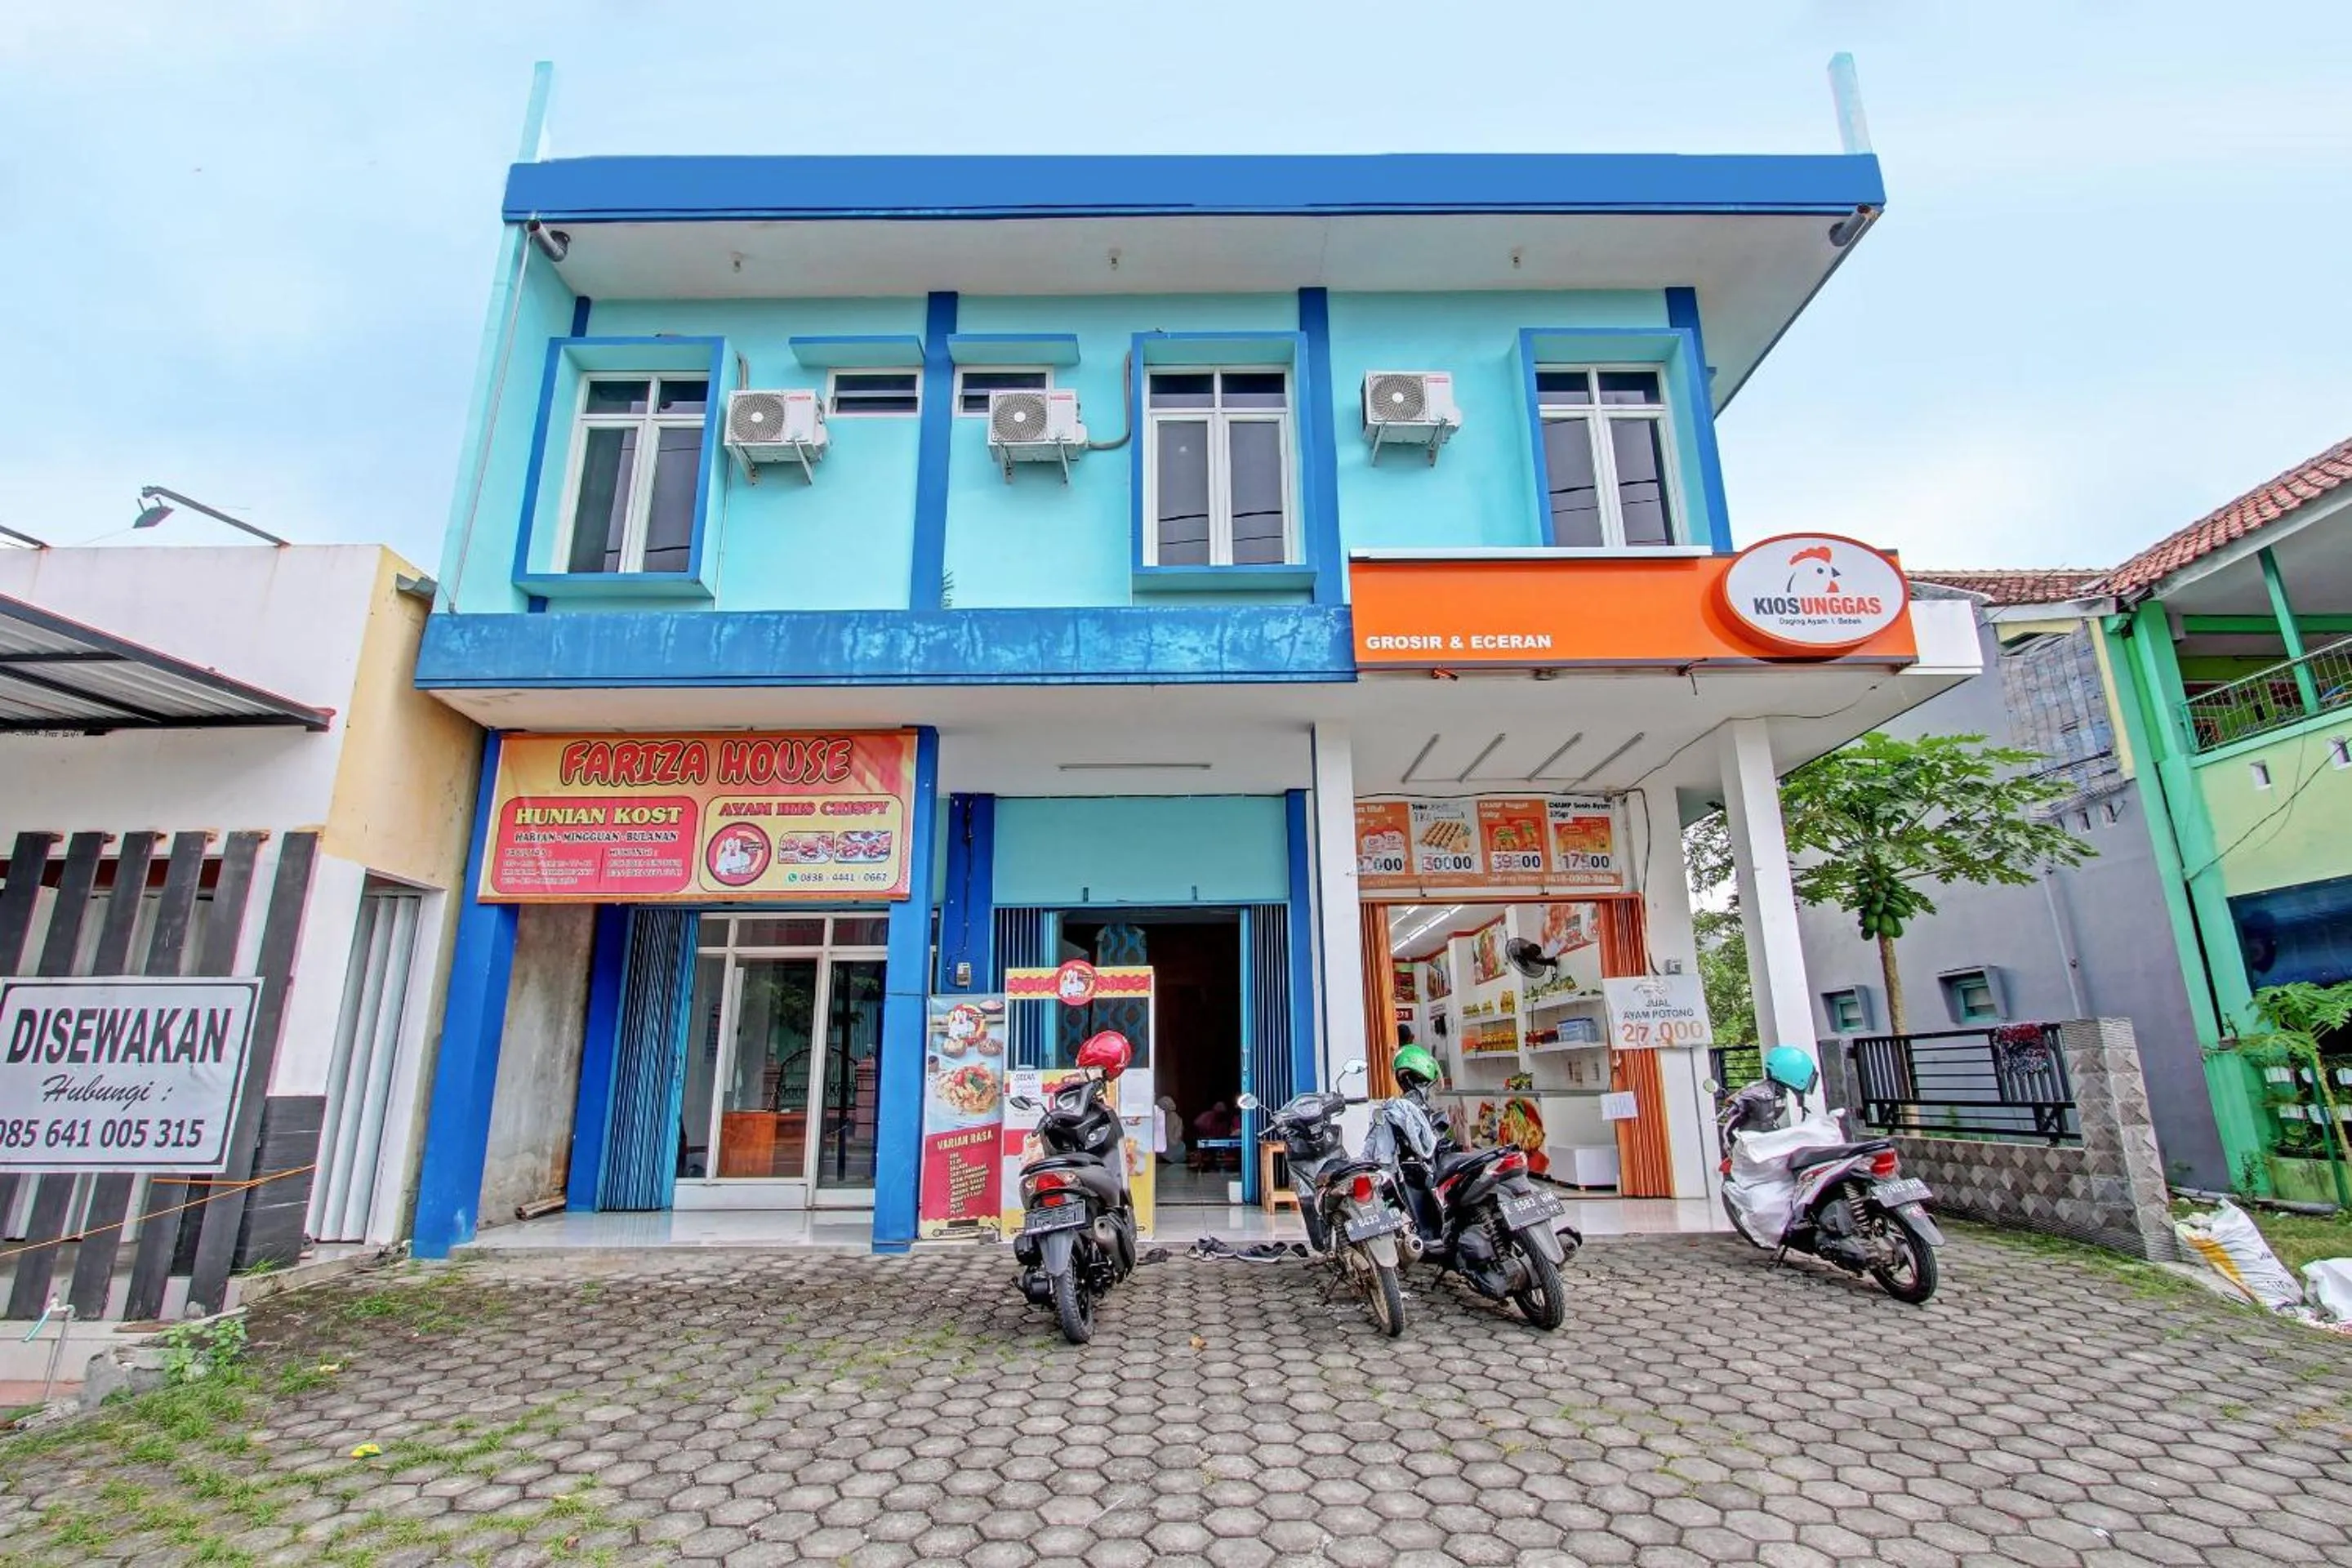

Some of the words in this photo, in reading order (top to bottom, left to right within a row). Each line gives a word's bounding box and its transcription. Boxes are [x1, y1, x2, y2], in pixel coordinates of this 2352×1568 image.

[1753, 597, 1882, 615] KIOSUNGGAS
[1780, 617, 1806, 626] Daging
[1365, 635, 1443, 649] GROSIR
[1450, 635, 1464, 649] &
[1470, 635, 1552, 649] ECERAN
[560, 740, 708, 787] FARIZA
[717, 737, 853, 786] HOUSE
[514, 807, 607, 826] HUNIAN
[612, 806, 684, 825] KOST
[719, 802, 773, 816] AYAM
[820, 801, 890, 816] CRISPY
[514, 831, 556, 842] HARIAN
[562, 831, 620, 842] MINGGUAN
[626, 831, 679, 841] BULANAN
[1646, 999, 1672, 1008] JUAL
[1623, 1010, 1650, 1020] AYAM
[1652, 1008, 1695, 1019] POTONG
[7, 1008, 232, 1063] DISEWAKAN
[42, 1074, 154, 1111] Hubungi
[45, 1119, 90, 1148] 641
[100, 1119, 148, 1148] 005
[154, 1119, 204, 1148] 315
[937, 1134, 969, 1151] VARIAN
[969, 1129, 994, 1144] RASA
